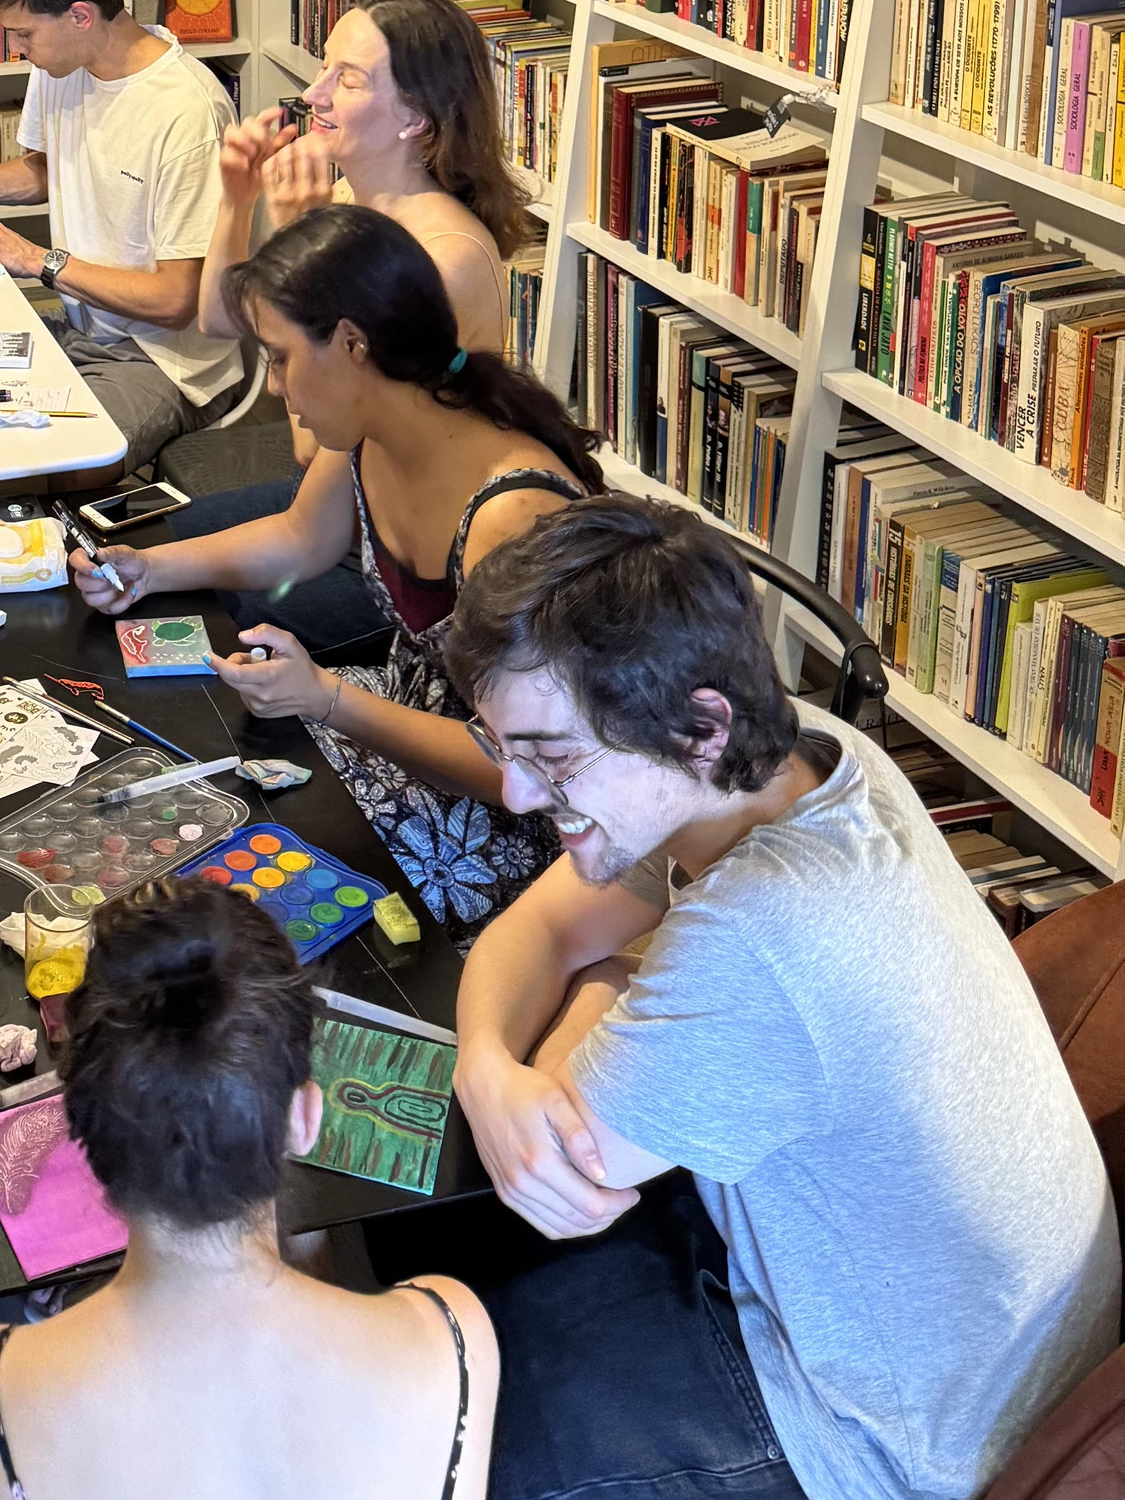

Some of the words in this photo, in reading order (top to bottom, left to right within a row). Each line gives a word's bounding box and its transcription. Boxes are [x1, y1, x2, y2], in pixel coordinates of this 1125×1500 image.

[839, 0, 848, 41] MORRER
[956, 59, 961, 68] DE
[988, 50, 997, 104] REVOLUÇÕES
[1073, 73, 1081, 92] GERAL
[987, 105, 993, 116] AS
[1057, 90, 1066, 125] SOCIOLOGIA
[1070, 95, 1079, 130] SOCIOLOGIA
[860, 292, 869, 331] LIBERDADE
[881, 310, 892, 331] LAVA
[957, 303, 966, 331] VOTO
[881, 332, 891, 356] JATO
[956, 331, 965, 348] DO
[1031, 357, 1039, 392] PREPARAR
[1026, 393, 1037, 425] CRISE
[1016, 406, 1026, 450] VENCER
[889, 528, 902, 547] 15
